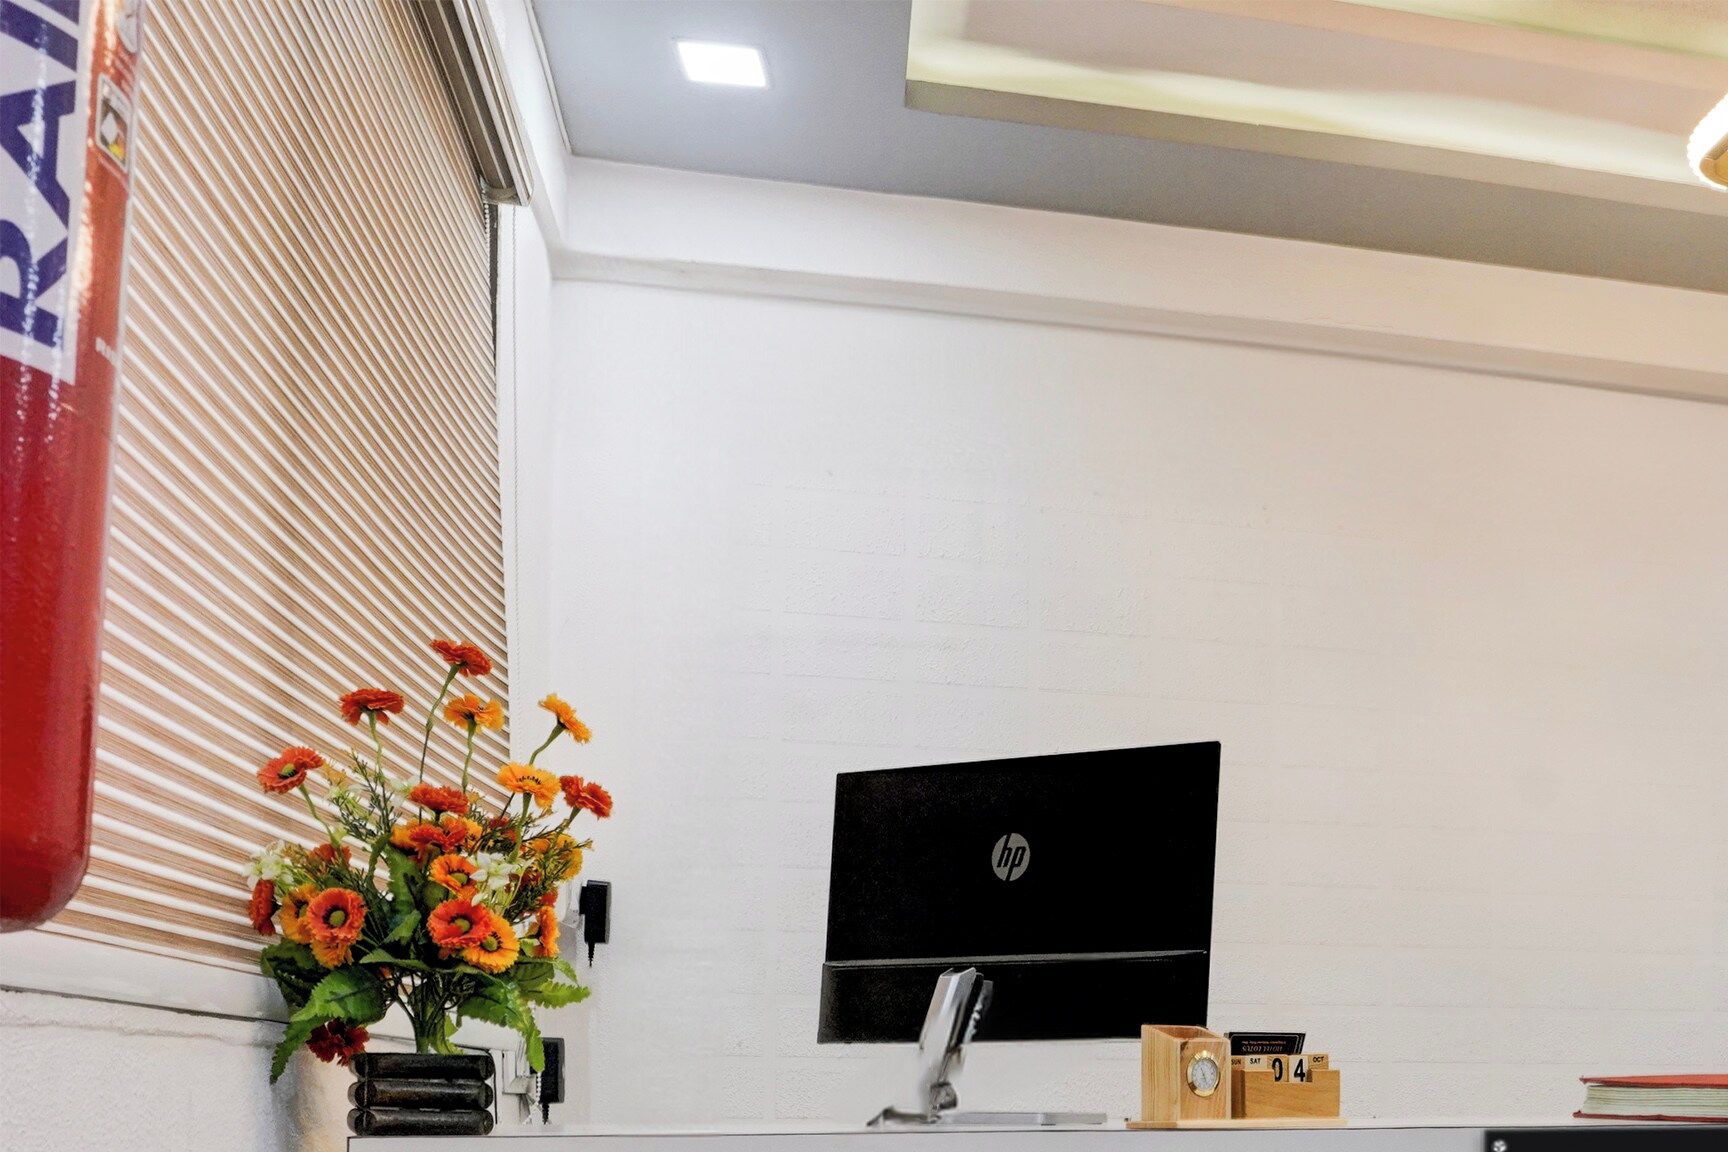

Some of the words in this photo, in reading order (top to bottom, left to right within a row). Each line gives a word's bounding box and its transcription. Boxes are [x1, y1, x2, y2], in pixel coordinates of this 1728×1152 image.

[0, 0, 79, 348] RAI
[997, 834, 1026, 880] hp
[1250, 1057, 1261, 1065] SAT
[1312, 1055, 1325, 1063] OCT
